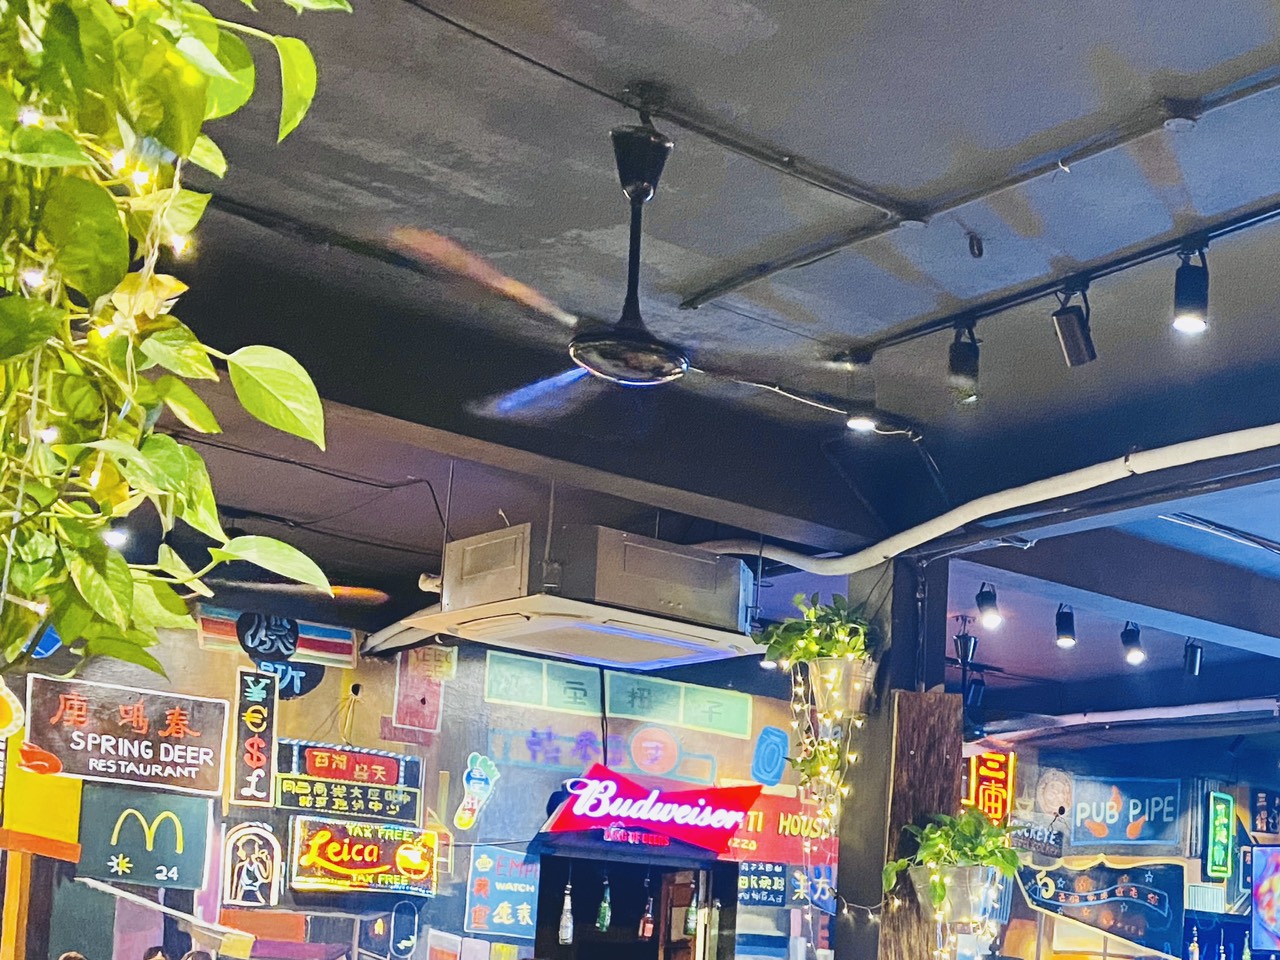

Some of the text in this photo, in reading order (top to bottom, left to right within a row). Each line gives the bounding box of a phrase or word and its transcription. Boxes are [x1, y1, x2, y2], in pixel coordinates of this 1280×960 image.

[70, 731, 215, 766] SPRING DEER
[88, 758, 200, 779] RESTAURANT
[564, 778, 744, 830] Budweiser
[1076, 796, 1174, 827] PUB PIPE
[346, 824, 414, 842] TAX FREE
[300, 829, 392, 873] Leica
[155, 865, 179, 881] 24
[351, 873, 410, 886] TAX FREE
[495, 881, 535, 893] WATCH
